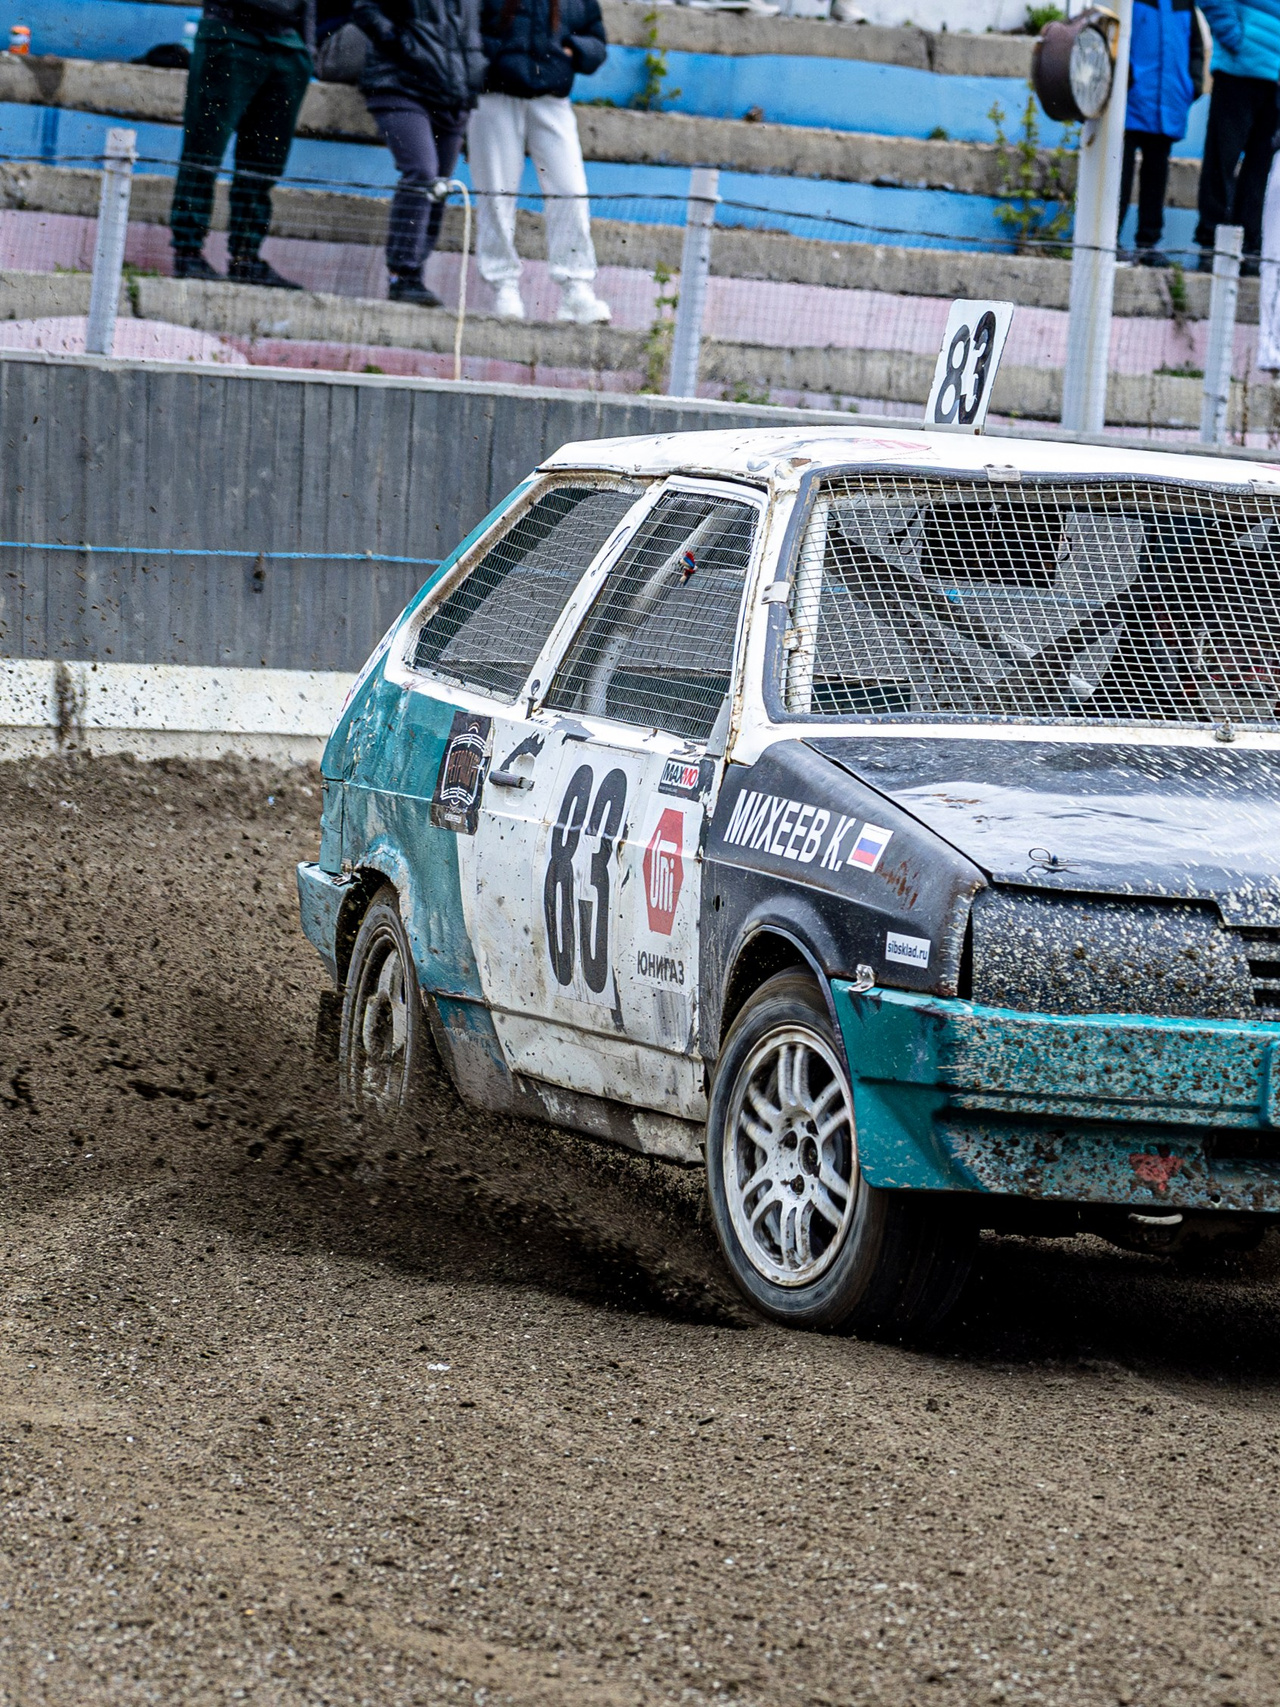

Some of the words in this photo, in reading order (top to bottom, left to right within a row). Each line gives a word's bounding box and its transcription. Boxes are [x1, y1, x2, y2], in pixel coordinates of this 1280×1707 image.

[935, 311, 996, 424] 83
[723, 789, 830, 863] МИХЕЕВ
[820, 815, 856, 872] К.
[544, 764, 628, 993] 83
[637, 950, 685, 986] ЮНИГАЗ
[888, 940, 928, 960] sibsklad.ru
